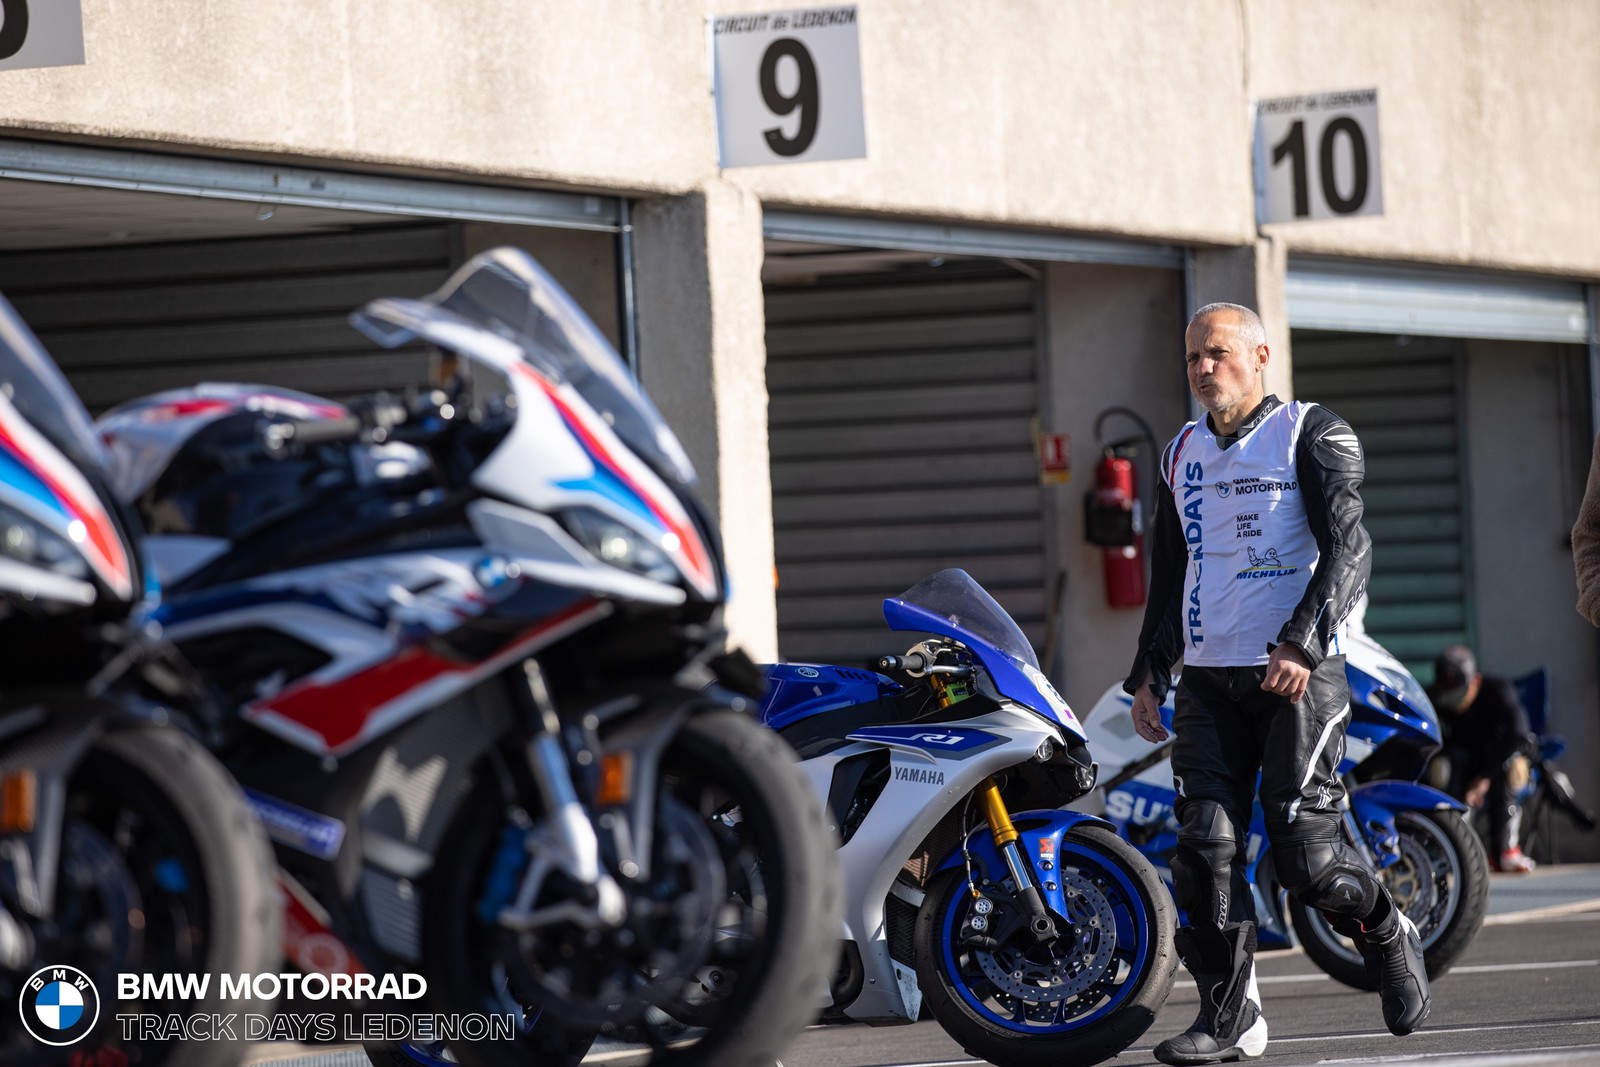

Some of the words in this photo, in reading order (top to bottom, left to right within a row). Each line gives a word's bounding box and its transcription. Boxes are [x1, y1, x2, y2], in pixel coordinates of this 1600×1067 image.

[759, 36, 819, 157] 9
[1271, 115, 1370, 218] 10
[1235, 481, 1298, 496] MOTORRAD
[1236, 513, 1260, 523] MAKE
[1236, 522, 1252, 531] LIFE
[1236, 531, 1242, 539] A
[1243, 529, 1263, 538] RIDE
[1236, 568, 1298, 580] MICHELIN
[894, 766, 945, 786] YAMAHA
